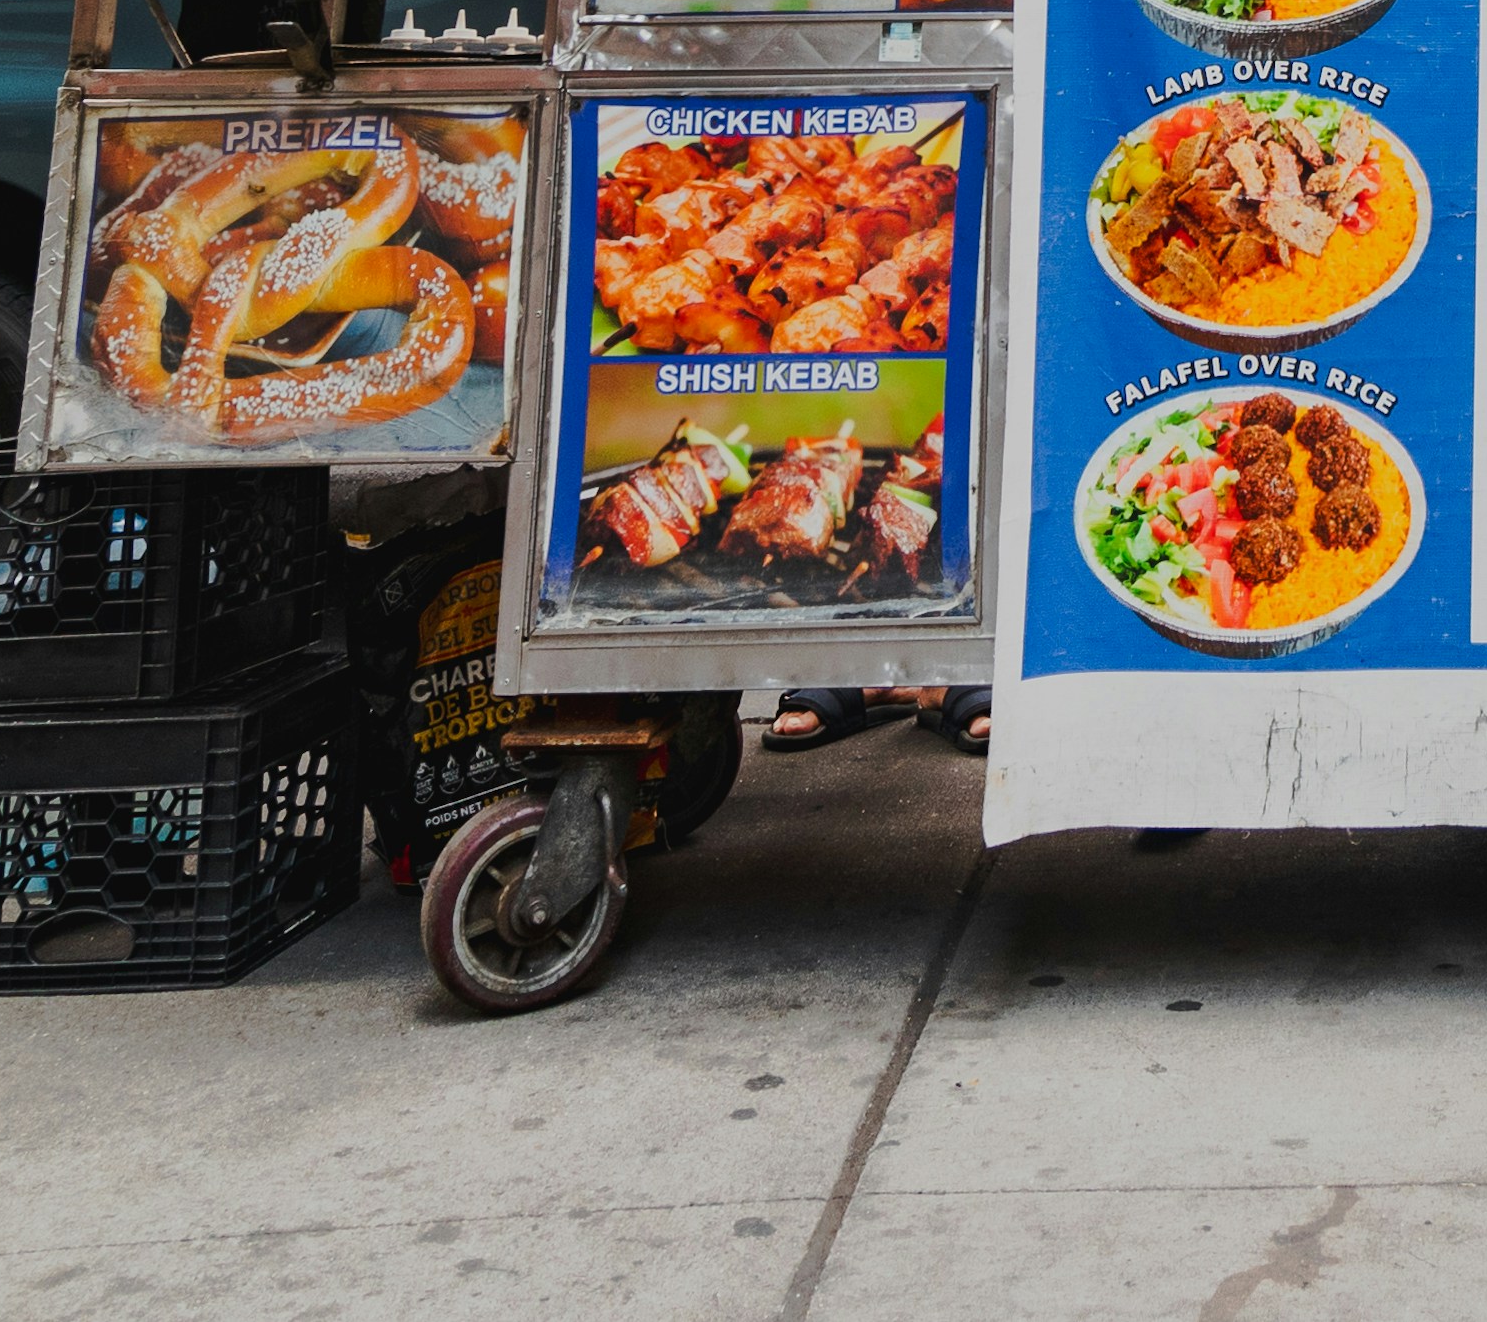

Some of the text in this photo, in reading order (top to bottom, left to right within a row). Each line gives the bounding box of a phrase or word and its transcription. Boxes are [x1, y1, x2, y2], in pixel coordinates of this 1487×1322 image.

[1145, 59, 1389, 109] LAMB OVER RICE
[223, 113, 402, 152] PRETZEL
[645, 104, 917, 137] CHICKEN KEBAB
[656, 360, 880, 394] SHISH KEBAB
[1103, 353, 1399, 417] FALAFEL OVER RICE
[421, 628, 464, 658] DEL
[424, 691, 462, 727] DE
[424, 803, 483, 828] POIDS NET
